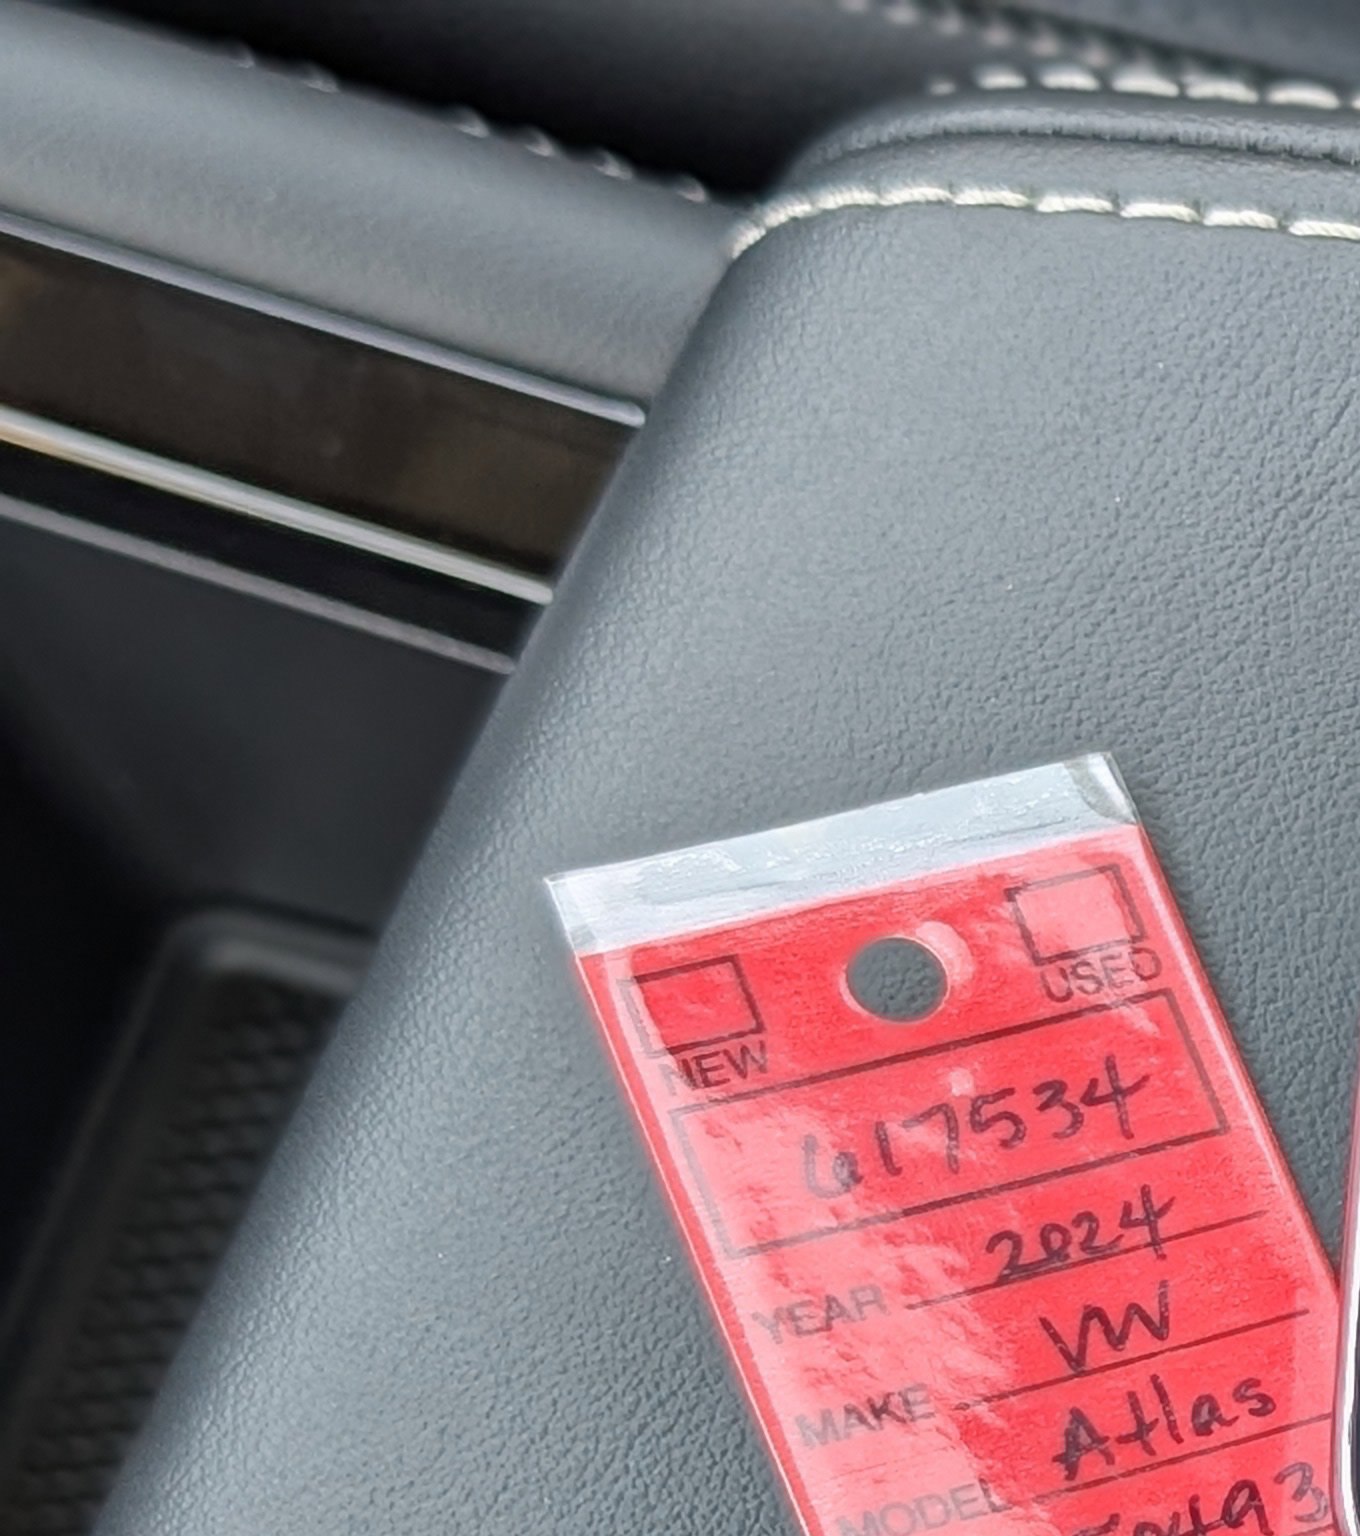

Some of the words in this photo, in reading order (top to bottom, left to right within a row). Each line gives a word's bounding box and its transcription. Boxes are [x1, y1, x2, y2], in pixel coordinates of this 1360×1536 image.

[1040, 945, 1163, 1004] USED
[660, 1041, 769, 1095] NEW
[801, 1055, 1152, 1197] 617534
[985, 1183, 1176, 1280] 2024
[751, 1285, 890, 1346] YEAR
[1040, 1280, 1171, 1374] VW
[792, 1383, 936, 1450] MAKE
[1052, 1373, 1278, 1480] Atlas
